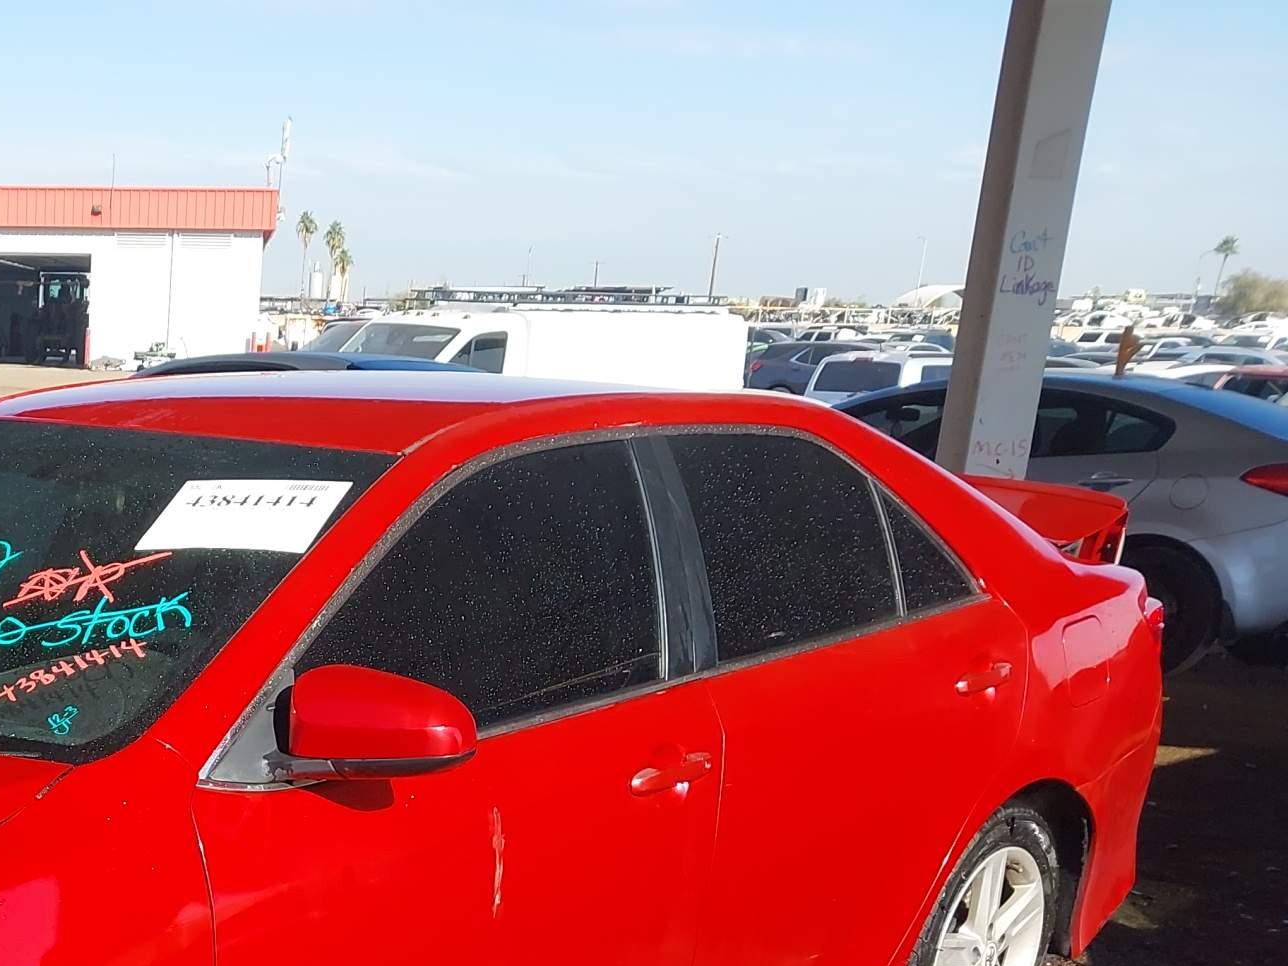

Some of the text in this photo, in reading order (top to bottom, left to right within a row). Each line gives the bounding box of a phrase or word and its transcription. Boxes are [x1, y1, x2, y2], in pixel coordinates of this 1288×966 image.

[1017, 255, 1034, 272] ID
[999, 273, 1056, 306] Linkage
[186, 494, 317, 508] 43841414
